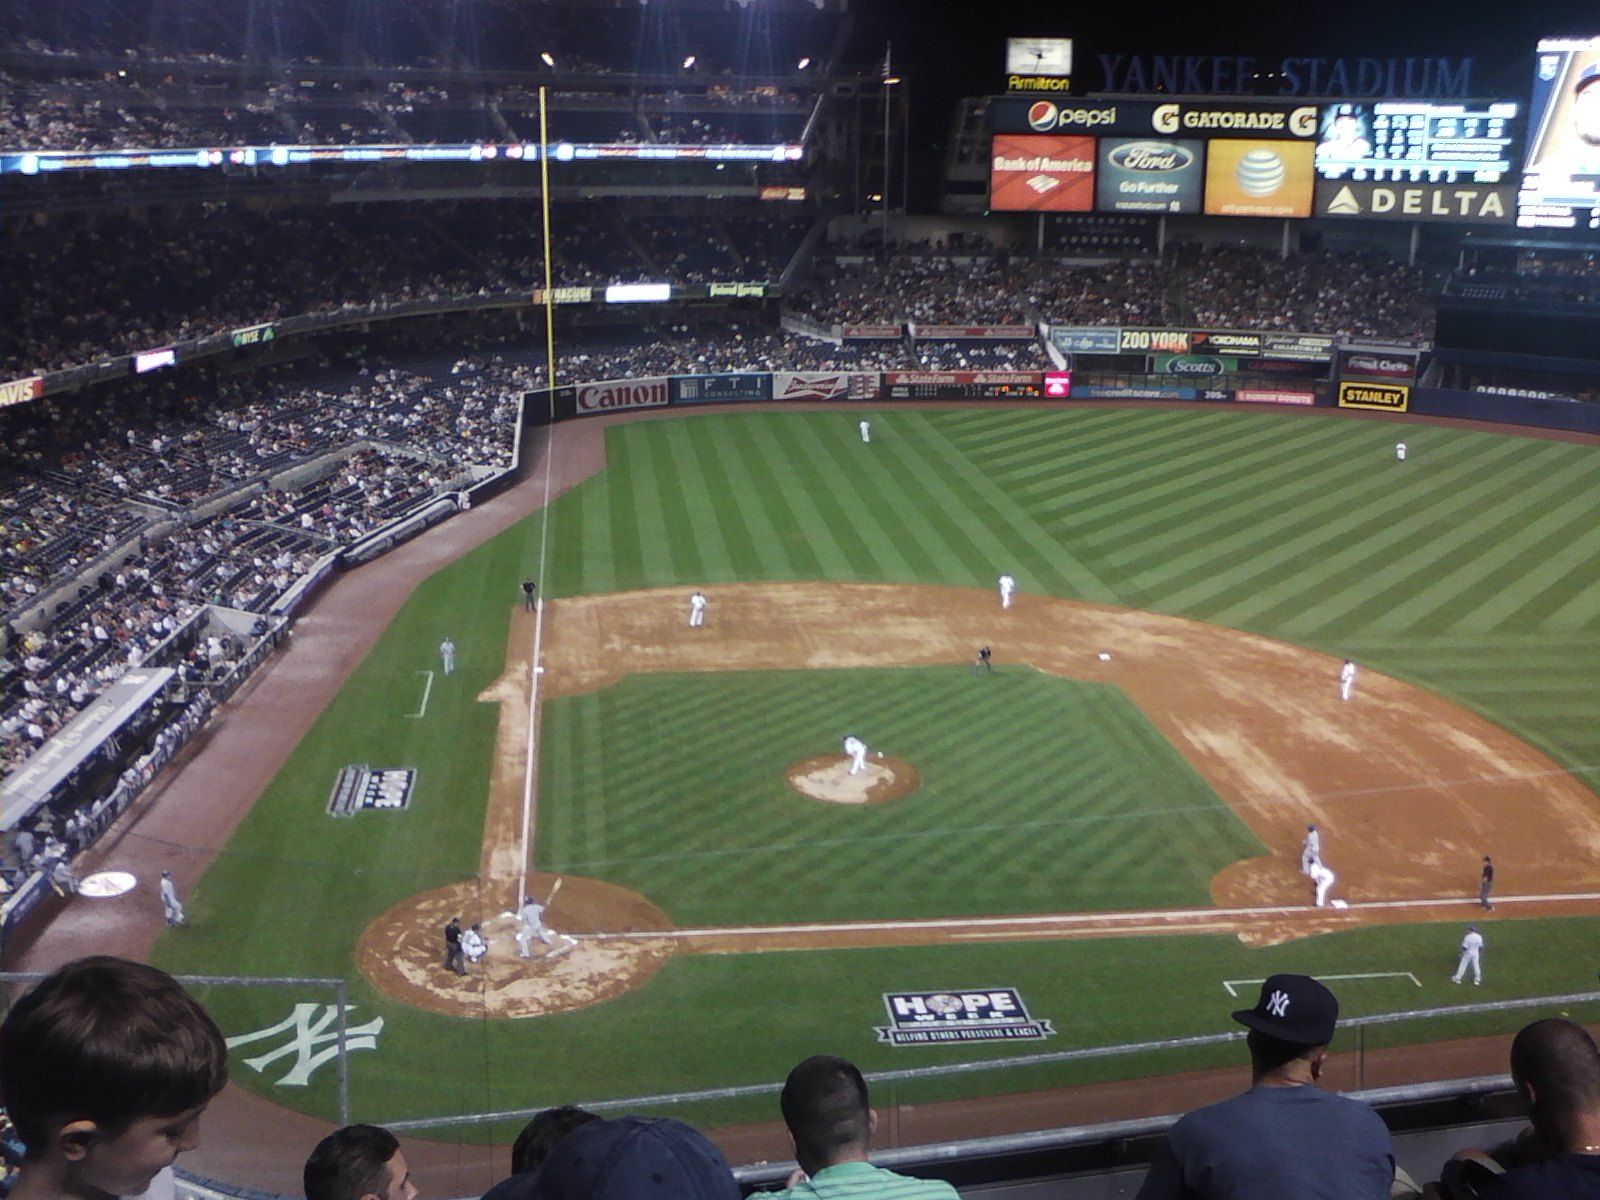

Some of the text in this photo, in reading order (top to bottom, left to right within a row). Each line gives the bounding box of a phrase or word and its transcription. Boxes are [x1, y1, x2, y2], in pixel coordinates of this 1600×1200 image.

[1008, 75, 1070, 90] Armitron
[1099, 54, 1474, 97] YANKEE STADIUM
[1058, 106, 1117, 127] pepsi
[1152, 104, 1317, 137] G GATORADE G
[994, 156, 1093, 172] Bank of America
[1122, 146, 1177, 170] Ford
[1370, 188, 1504, 217] DELTA
[1121, 332, 1149, 348] ZOO
[1151, 332, 1189, 351] YORK
[1174, 360, 1216, 373] Scotts
[578, 383, 666, 409] Canon
[1346, 389, 1401, 405] STANLEY
[893, 992, 1016, 1016] HOPE
[1266, 990, 1290, 1017] NY
[225, 1003, 384, 1086] NY
